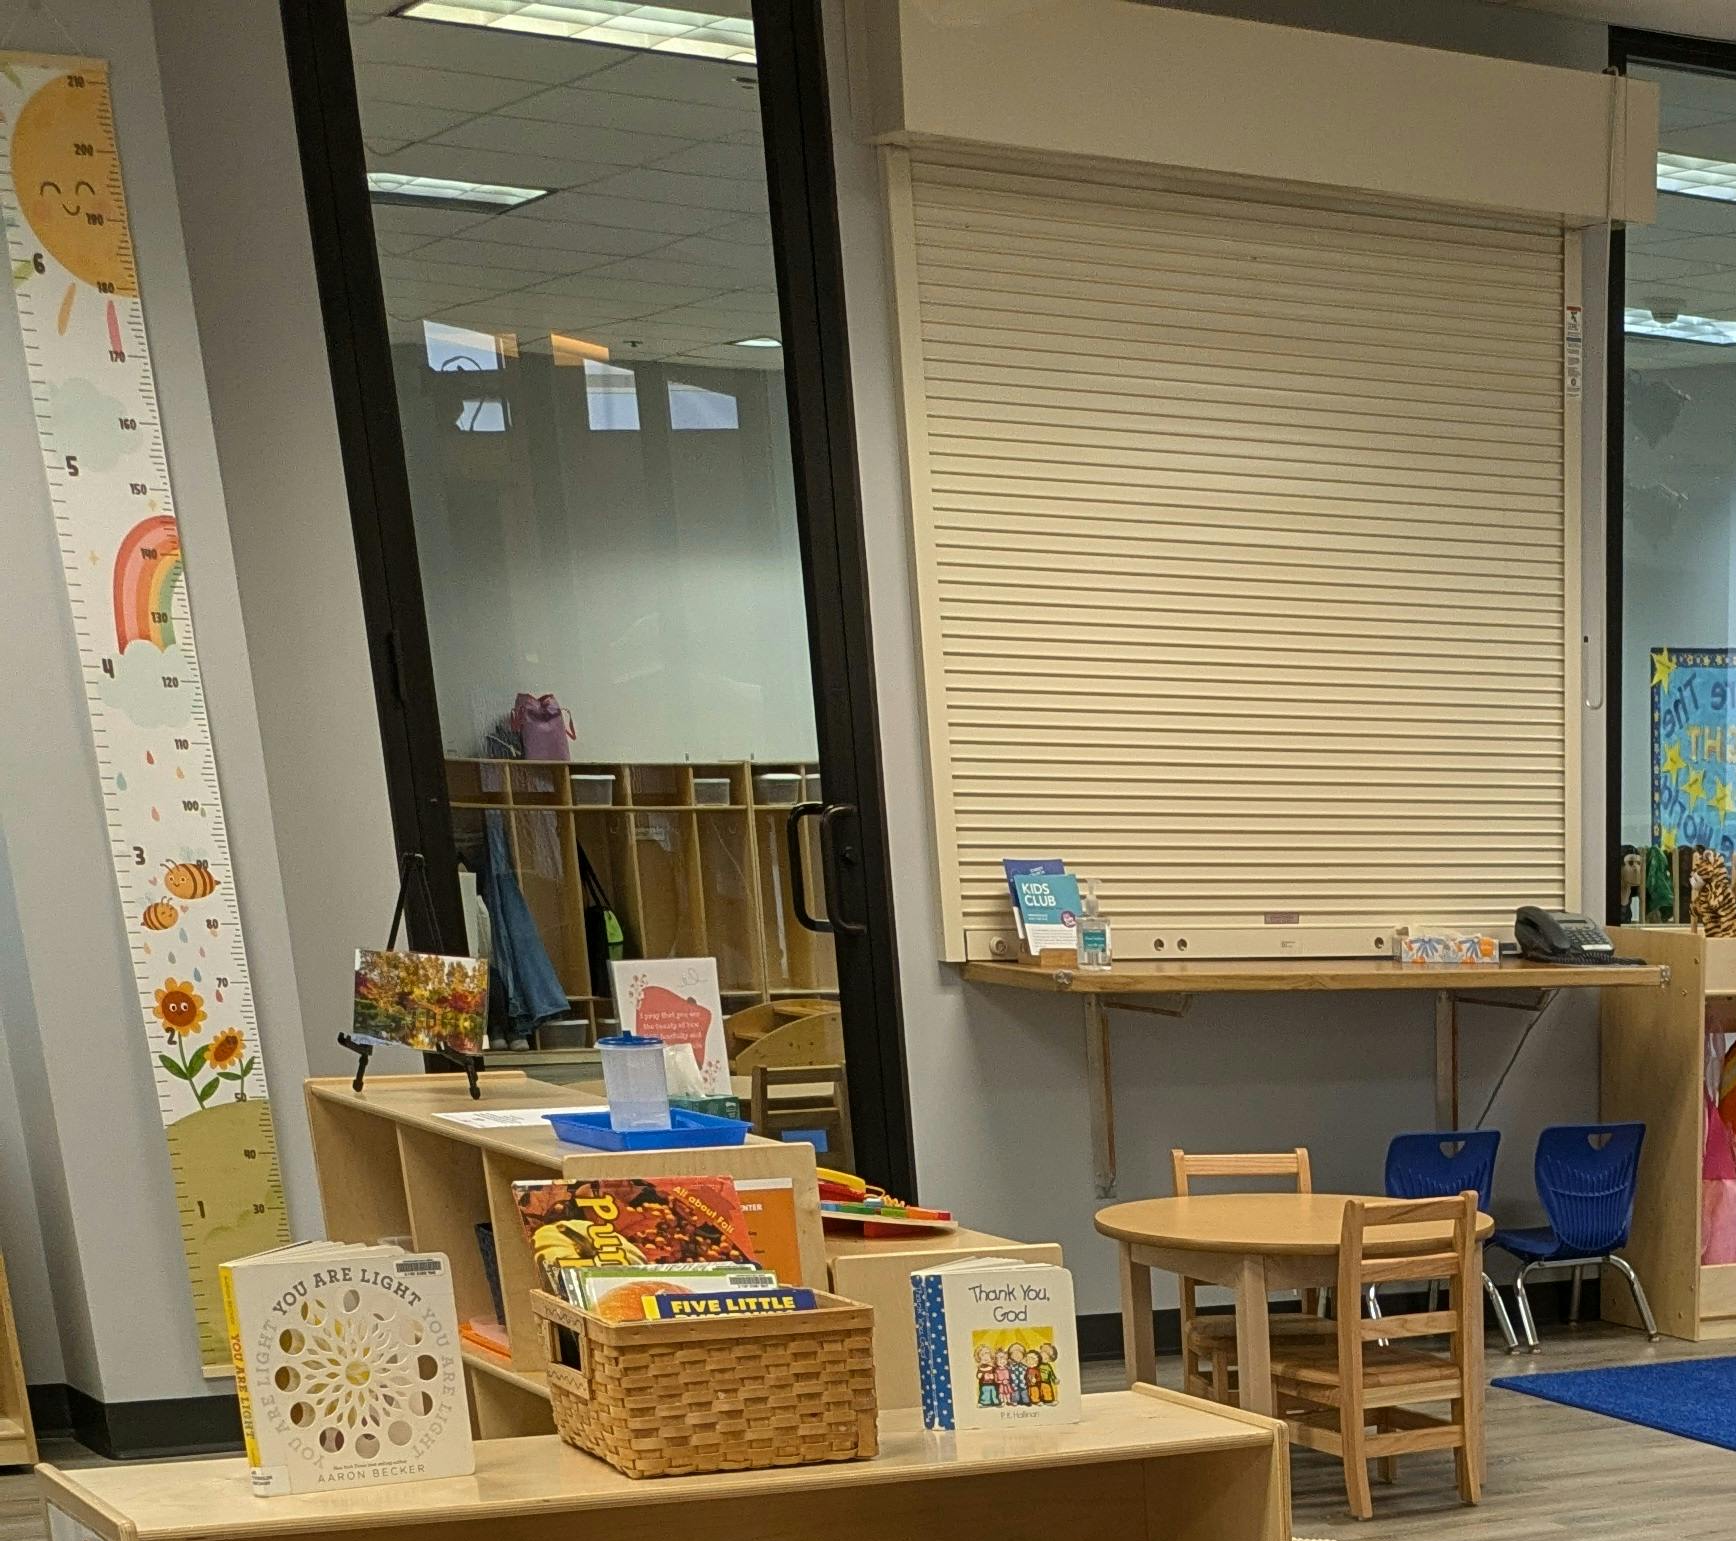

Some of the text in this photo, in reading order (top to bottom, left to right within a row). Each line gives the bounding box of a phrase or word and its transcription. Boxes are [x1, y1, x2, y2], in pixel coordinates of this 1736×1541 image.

[67, 76, 86, 88] 210
[74, 143, 94, 156] 200
[86, 212, 104, 226] 190
[33, 252, 46, 275] 6
[96, 280, 115, 294] 180
[108, 350, 126, 363] 170
[118, 417, 137, 431] 160
[65, 455, 79, 477] 5
[129, 482, 147, 496] 150
[140, 547, 158, 561] 140
[150, 611, 169, 624] 130
[101, 658, 115, 679] 4
[161, 675, 179, 689] 120
[174, 738, 189, 751] 110
[182, 799, 199, 812] 100
[133, 846, 146, 866] 3
[1021, 883, 1050, 895] KIDS
[1024, 895, 1057, 907] CLUB
[206, 918, 219, 930] 80
[216, 976, 229, 988] 70
[165, 1026, 178, 1046] 2
[243, 1149, 256, 1160] 40
[196, 1200, 208, 1219] 1
[253, 1202, 266, 1214] 30
[673, 1185, 687, 1197] All
[688, 1194, 718, 1221] about
[716, 1214, 735, 1235] Fall
[272, 1281, 308, 1317] YOU
[313, 1267, 353, 1290] ARE
[360, 1268, 422, 1308] LIGHT
[968, 1284, 1051, 1304] Thank You,
[671, 1296, 797, 1314] FIVE LITTLE
[993, 1305, 1029, 1323] God
[255, 1318, 278, 1388] LIGHT
[230, 1333, 255, 1441] YOU ARE LIGHT
[414, 1307, 457, 1460] YOU ARE LIGHT
[260, 1394, 291, 1435] ARE
[287, 1437, 326, 1469] YOU
[318, 1470, 367, 1483] AARON
[372, 1463, 426, 1478] BECKER
